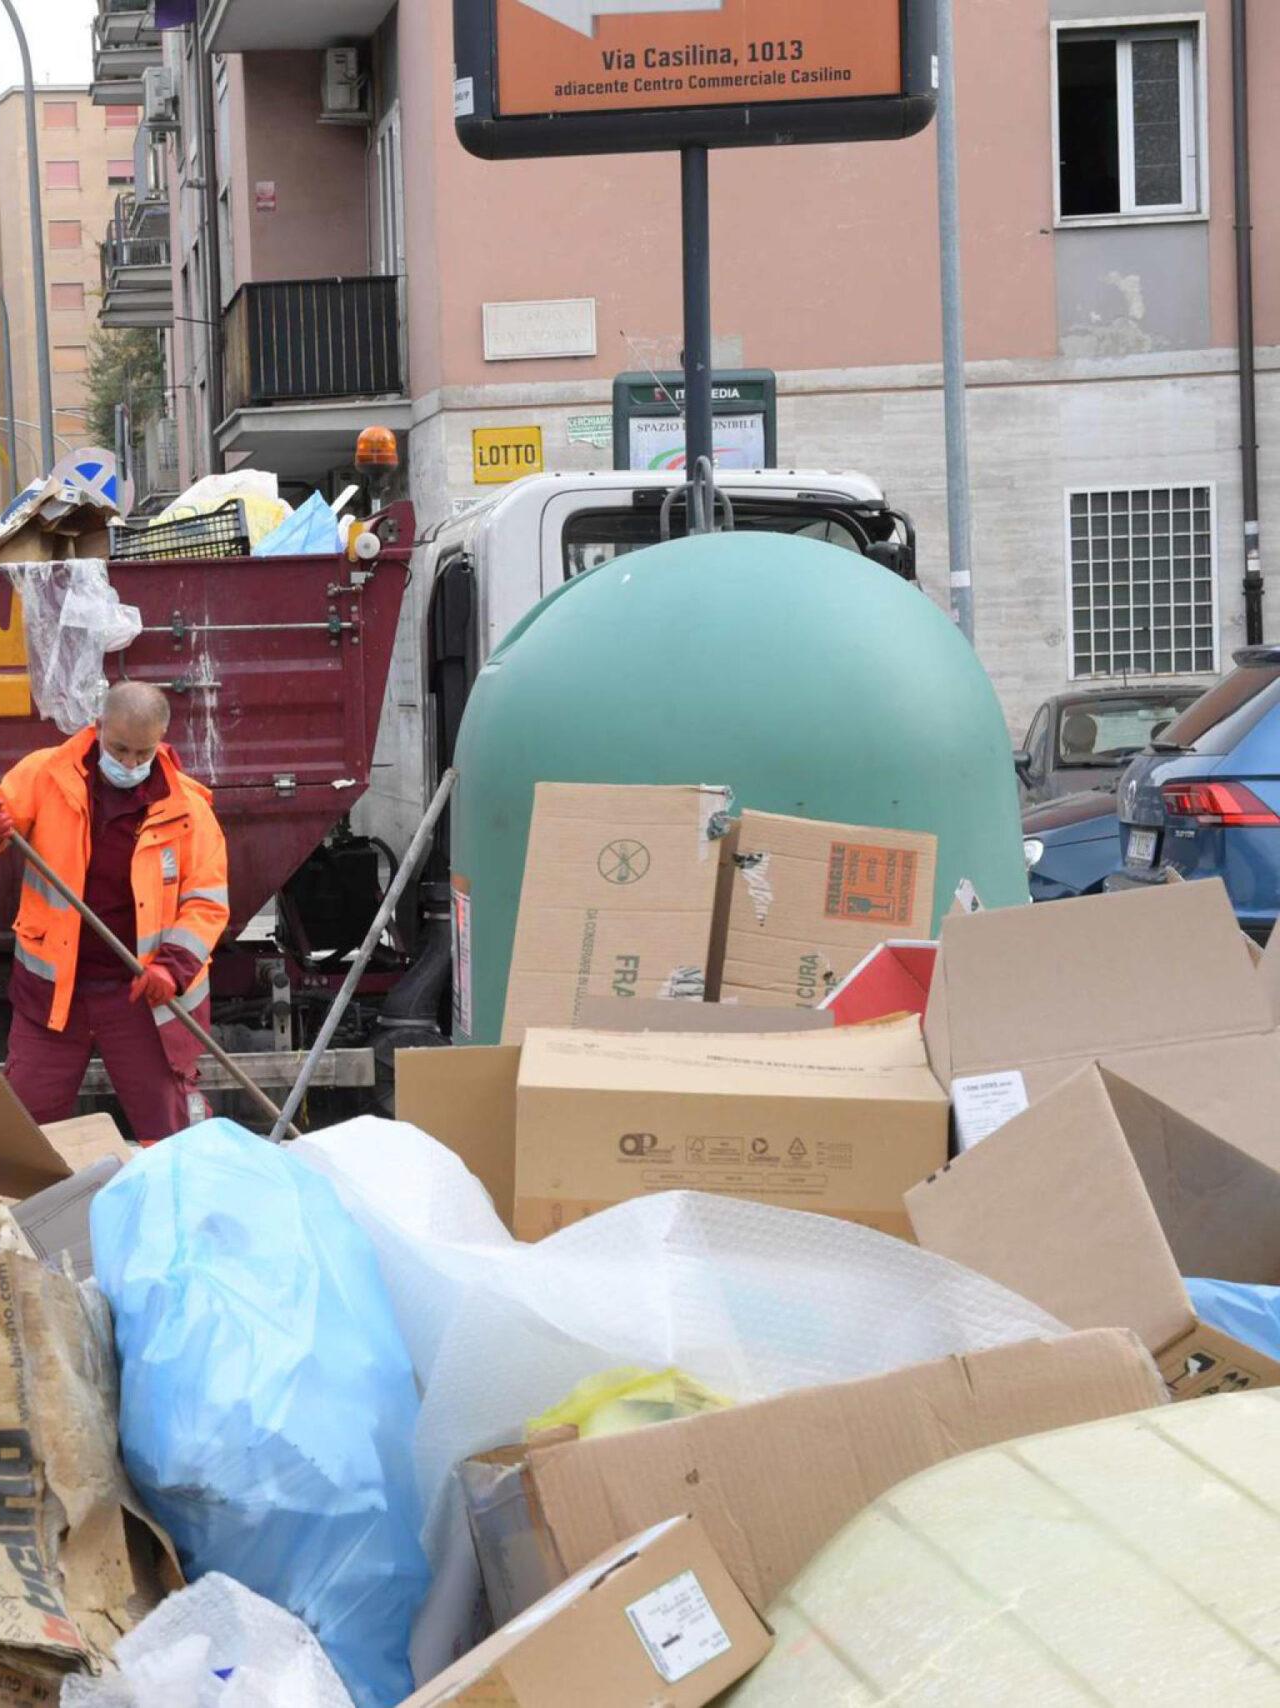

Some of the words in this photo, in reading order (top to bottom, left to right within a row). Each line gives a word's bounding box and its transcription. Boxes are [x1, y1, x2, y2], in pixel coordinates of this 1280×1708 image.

[601, 51, 635, 71] Via
[644, 43, 739, 69] Casilina,
[748, 39, 804, 63] 1013
[554, 79, 628, 97] adiacente
[634, 75, 683, 93] Centro
[689, 70, 786, 90] Commerciale
[791, 66, 852, 84] Casilino
[636, 422, 679, 433] SPAZIO
[826, 844, 845, 916] FRAGILE
[797, 954, 819, 998] CURA
